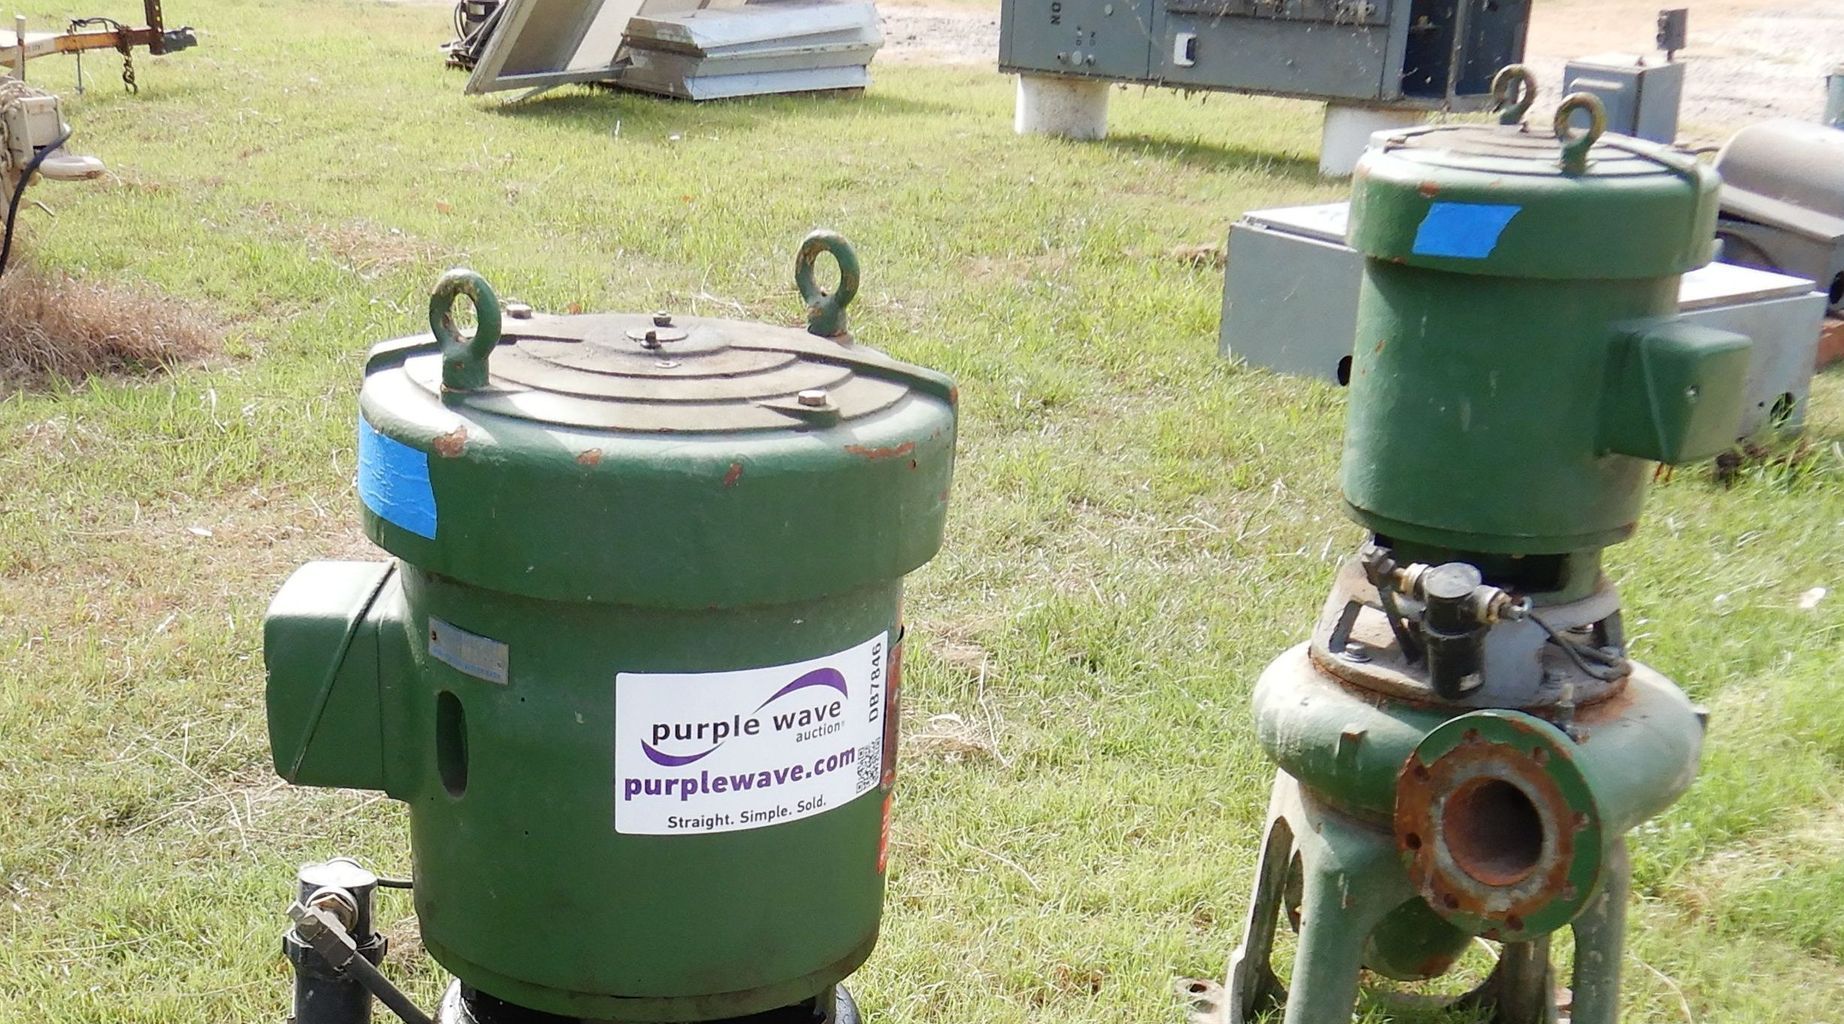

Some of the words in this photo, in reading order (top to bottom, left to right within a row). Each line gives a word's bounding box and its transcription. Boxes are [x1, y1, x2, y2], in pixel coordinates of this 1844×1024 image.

[868, 643, 882, 723] DB7846
[652, 714, 760, 745] purple
[773, 700, 841, 731] wave
[796, 723, 841, 742] auction
[624, 746, 856, 801] purplewave.com
[667, 814, 734, 829] Straight.
[740, 807, 792, 824] Simple.
[797, 794, 827, 813] Sold.
